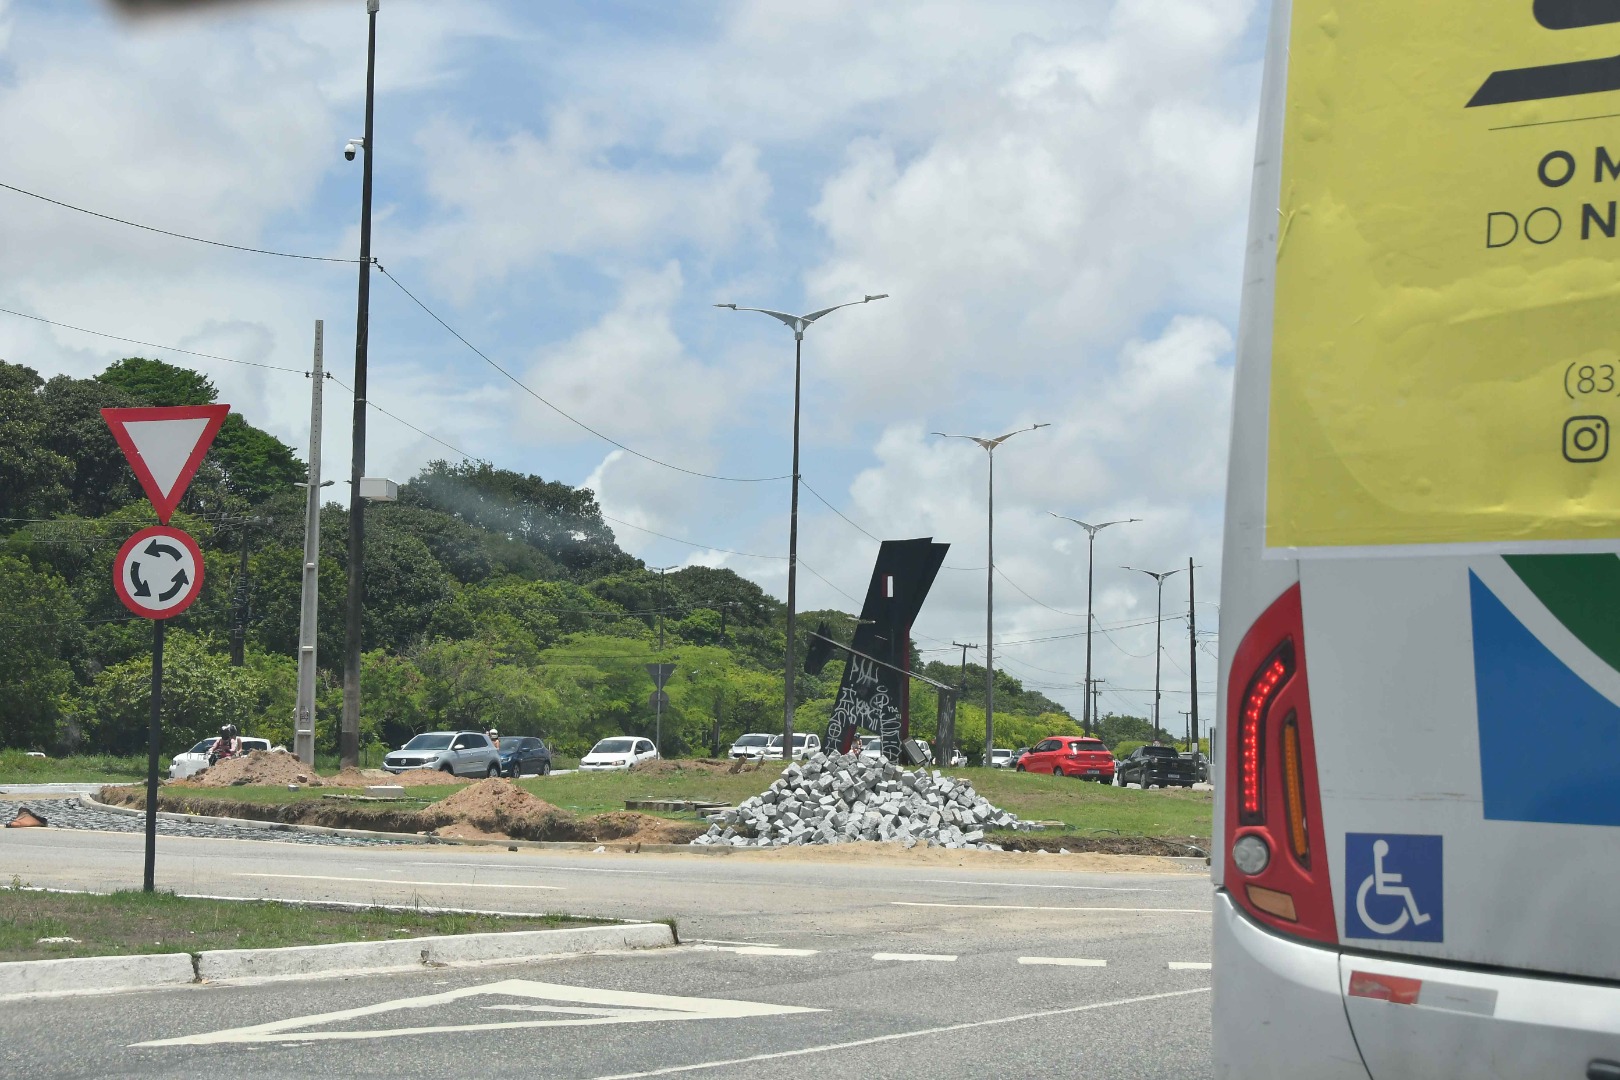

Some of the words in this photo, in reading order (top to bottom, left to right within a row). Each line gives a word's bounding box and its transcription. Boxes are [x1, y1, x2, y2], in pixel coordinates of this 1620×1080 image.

[1537, 150, 1576, 188] O
[1486, 206, 1562, 248] DO
[1581, 201, 1617, 240] N
